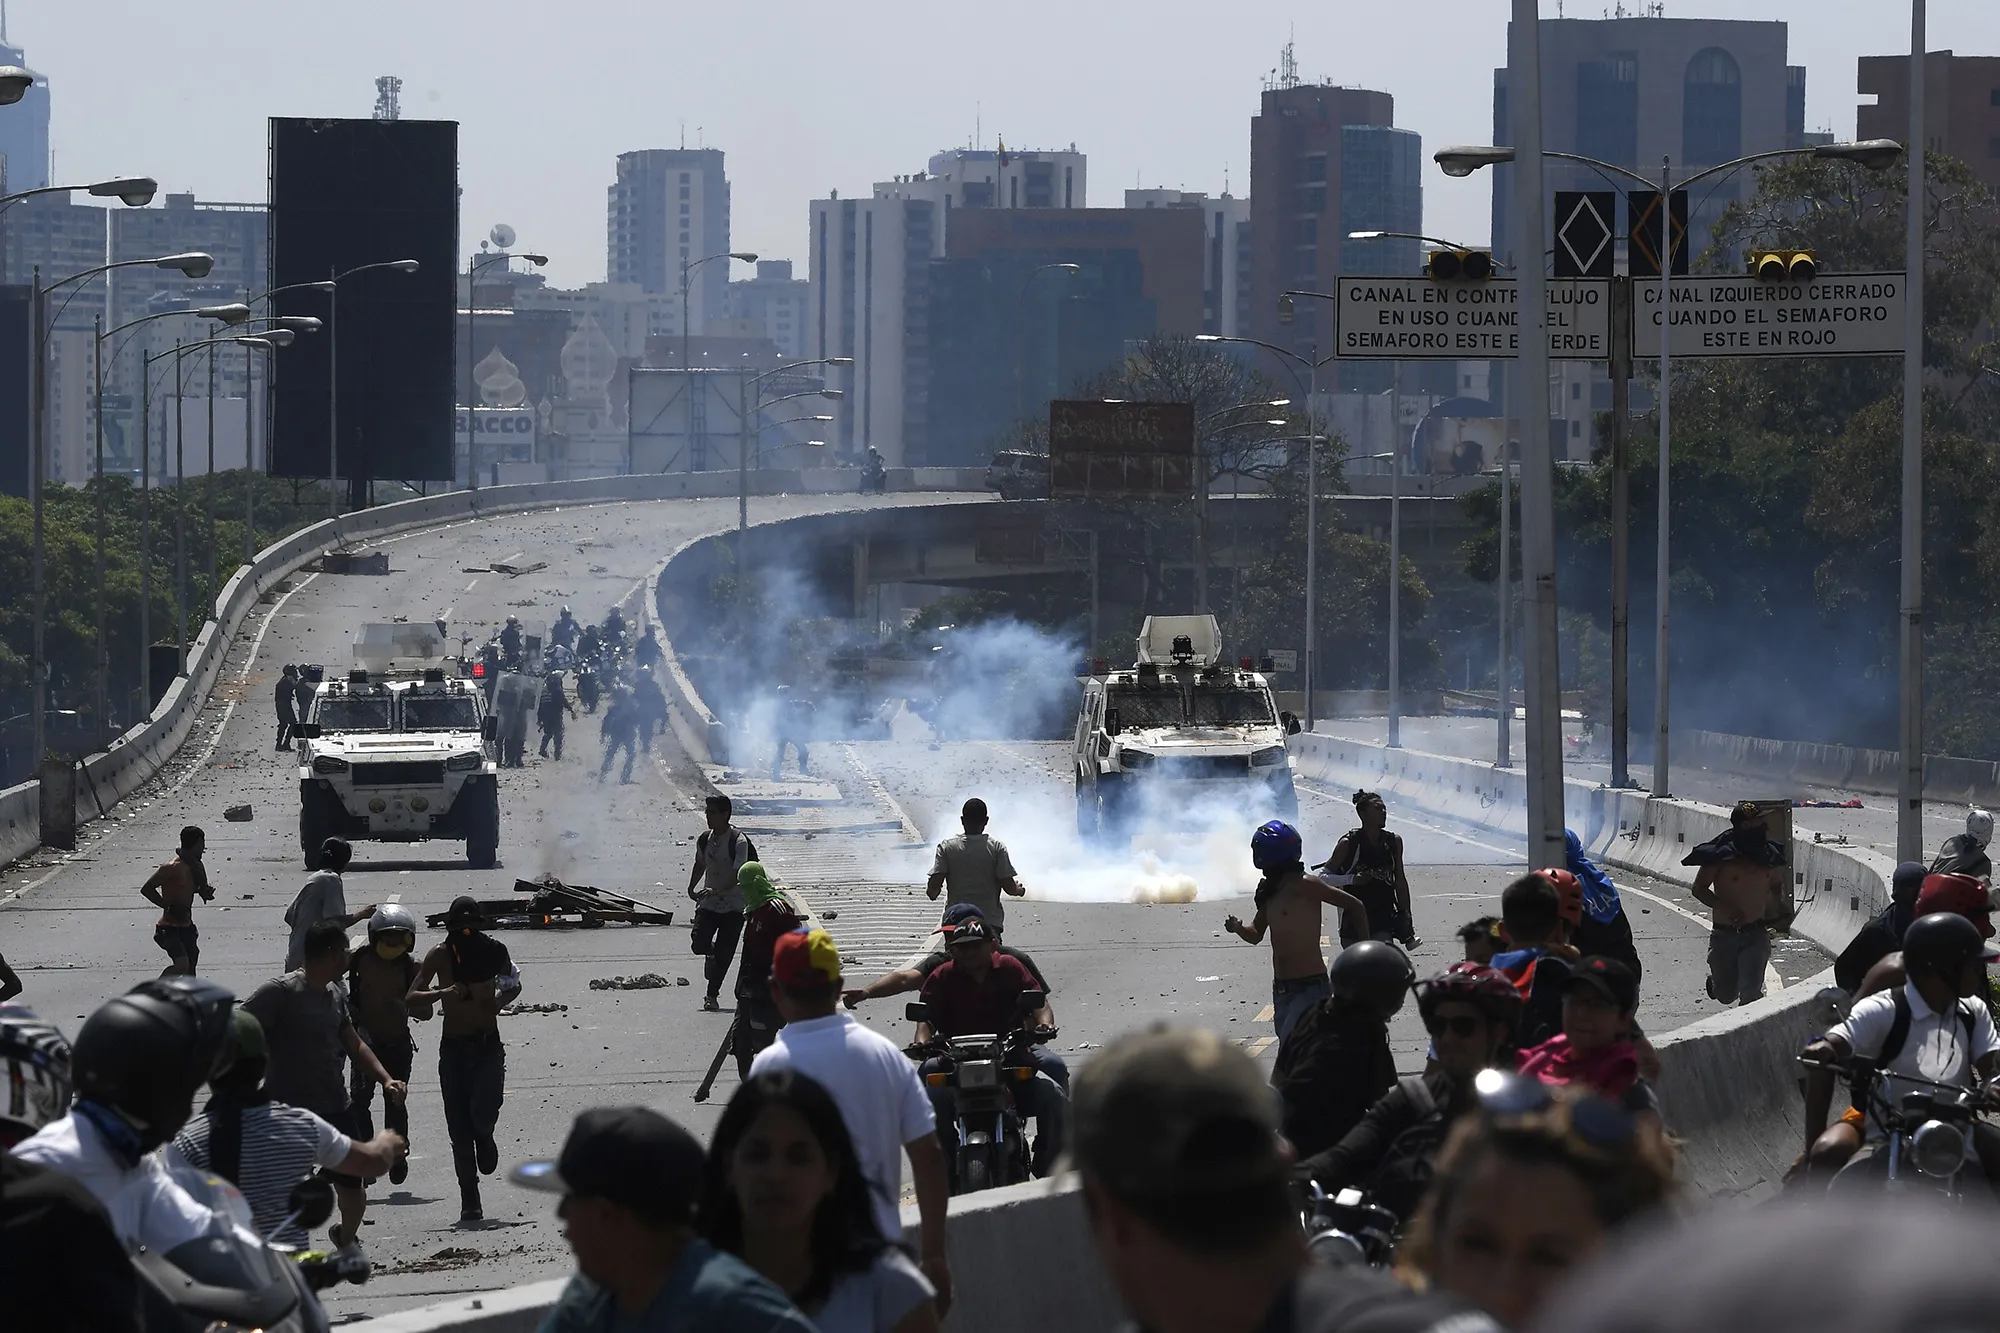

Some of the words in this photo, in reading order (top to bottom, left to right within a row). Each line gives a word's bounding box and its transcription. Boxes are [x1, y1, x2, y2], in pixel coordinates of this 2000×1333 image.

[1350, 287, 1417, 302] CANAL
[1423, 288, 1448, 303] EN
[1710, 286, 1802, 303] IZQUIERDO
[1809, 284, 1896, 300] CERRADO
[1379, 310, 1404, 325] EN
[1411, 311, 1449, 325] USO
[1547, 312, 1569, 327] EL
[1652, 309, 1737, 326] CUANDO
[1745, 309, 1769, 324] EL
[1777, 306, 1887, 323] SEMAFORO
[1347, 332, 1448, 348] SEMAFORO
[1456, 333, 1502, 349] ESTE
[1548, 334, 1600, 350] ERDE
[1703, 332, 1750, 347] ESTE
[1758, 331, 1781, 346] EN
[1788, 329, 1836, 345] ROJO
